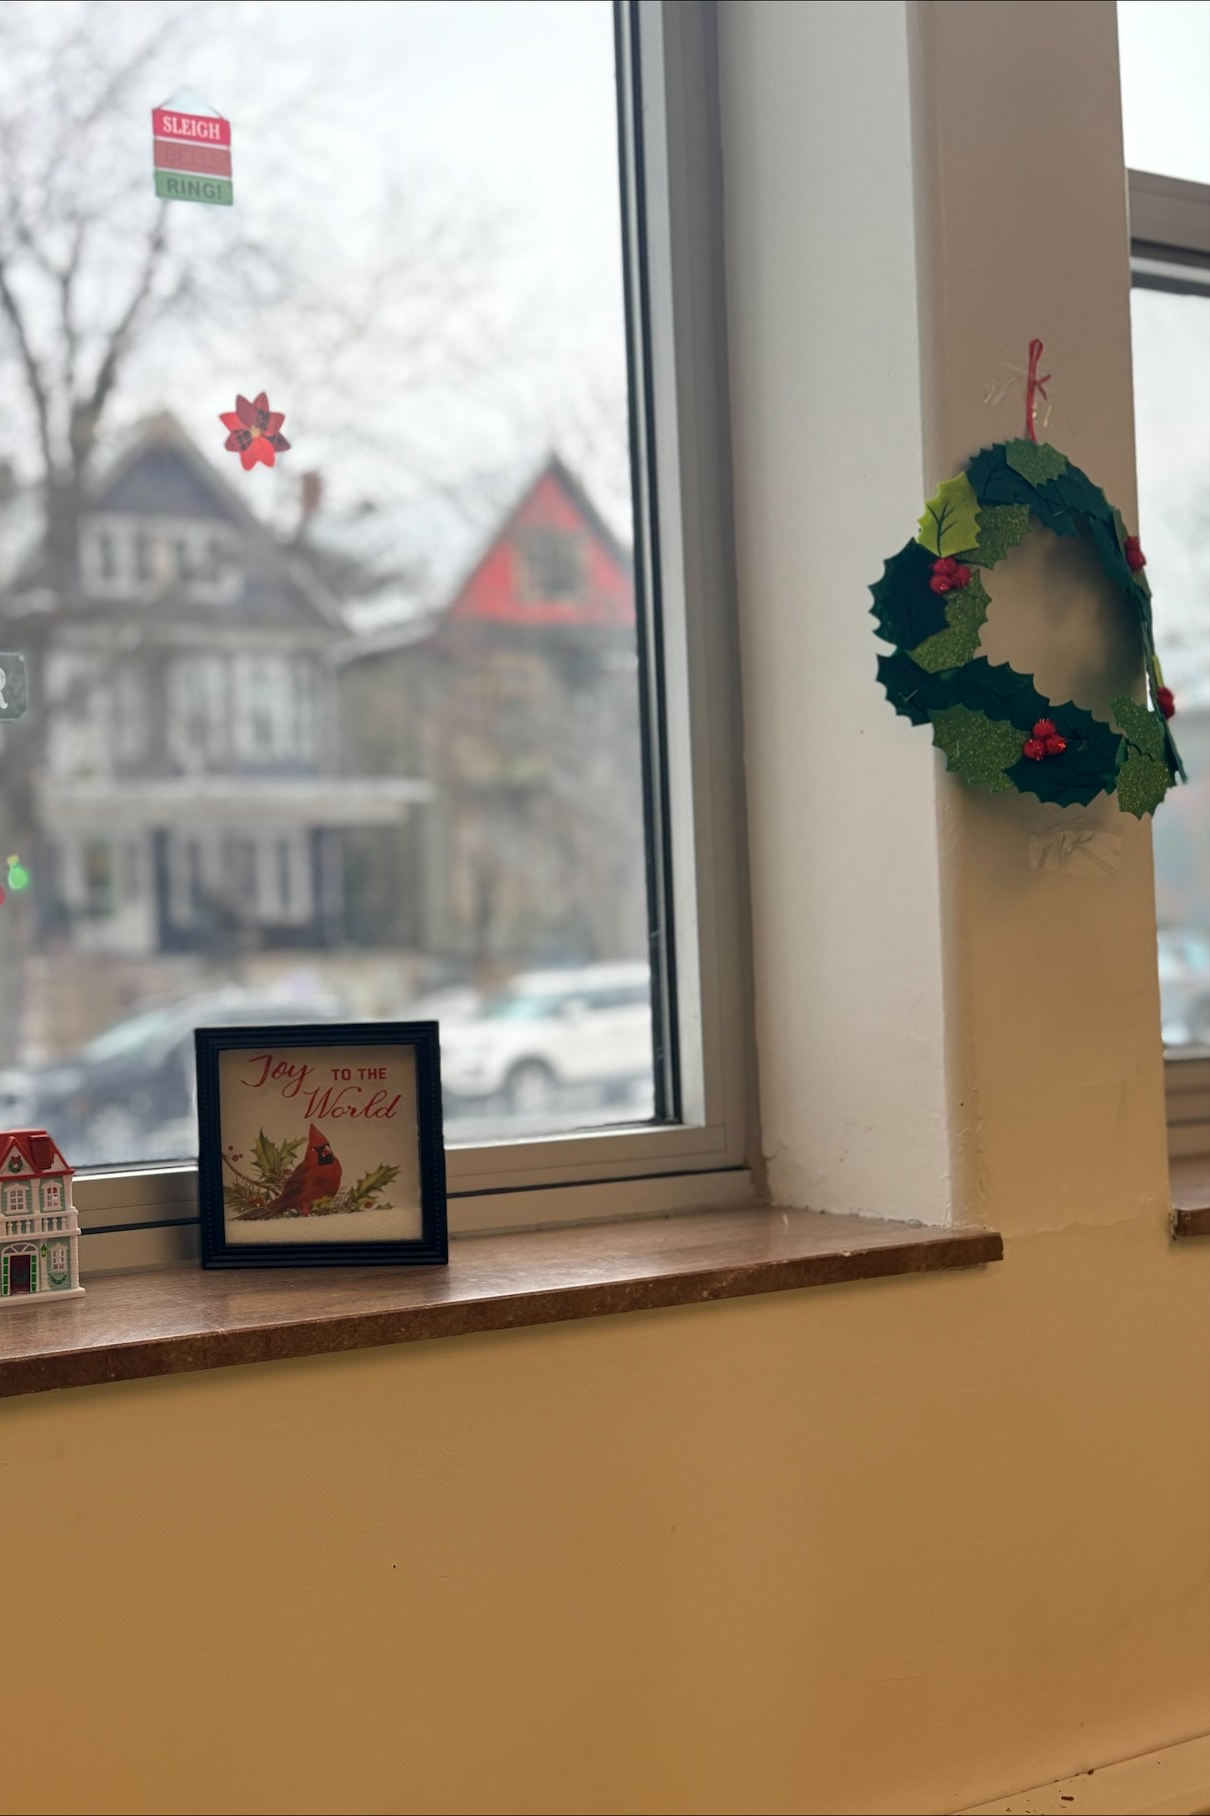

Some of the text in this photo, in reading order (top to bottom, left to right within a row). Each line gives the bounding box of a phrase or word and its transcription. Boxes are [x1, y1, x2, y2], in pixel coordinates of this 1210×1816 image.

[162, 115, 221, 140] SLEIGH
[165, 148, 221, 170] BELLS
[166, 178, 222, 200] RING!
[240, 1054, 388, 1098] Joy TO THE
[303, 1086, 402, 1119] World
